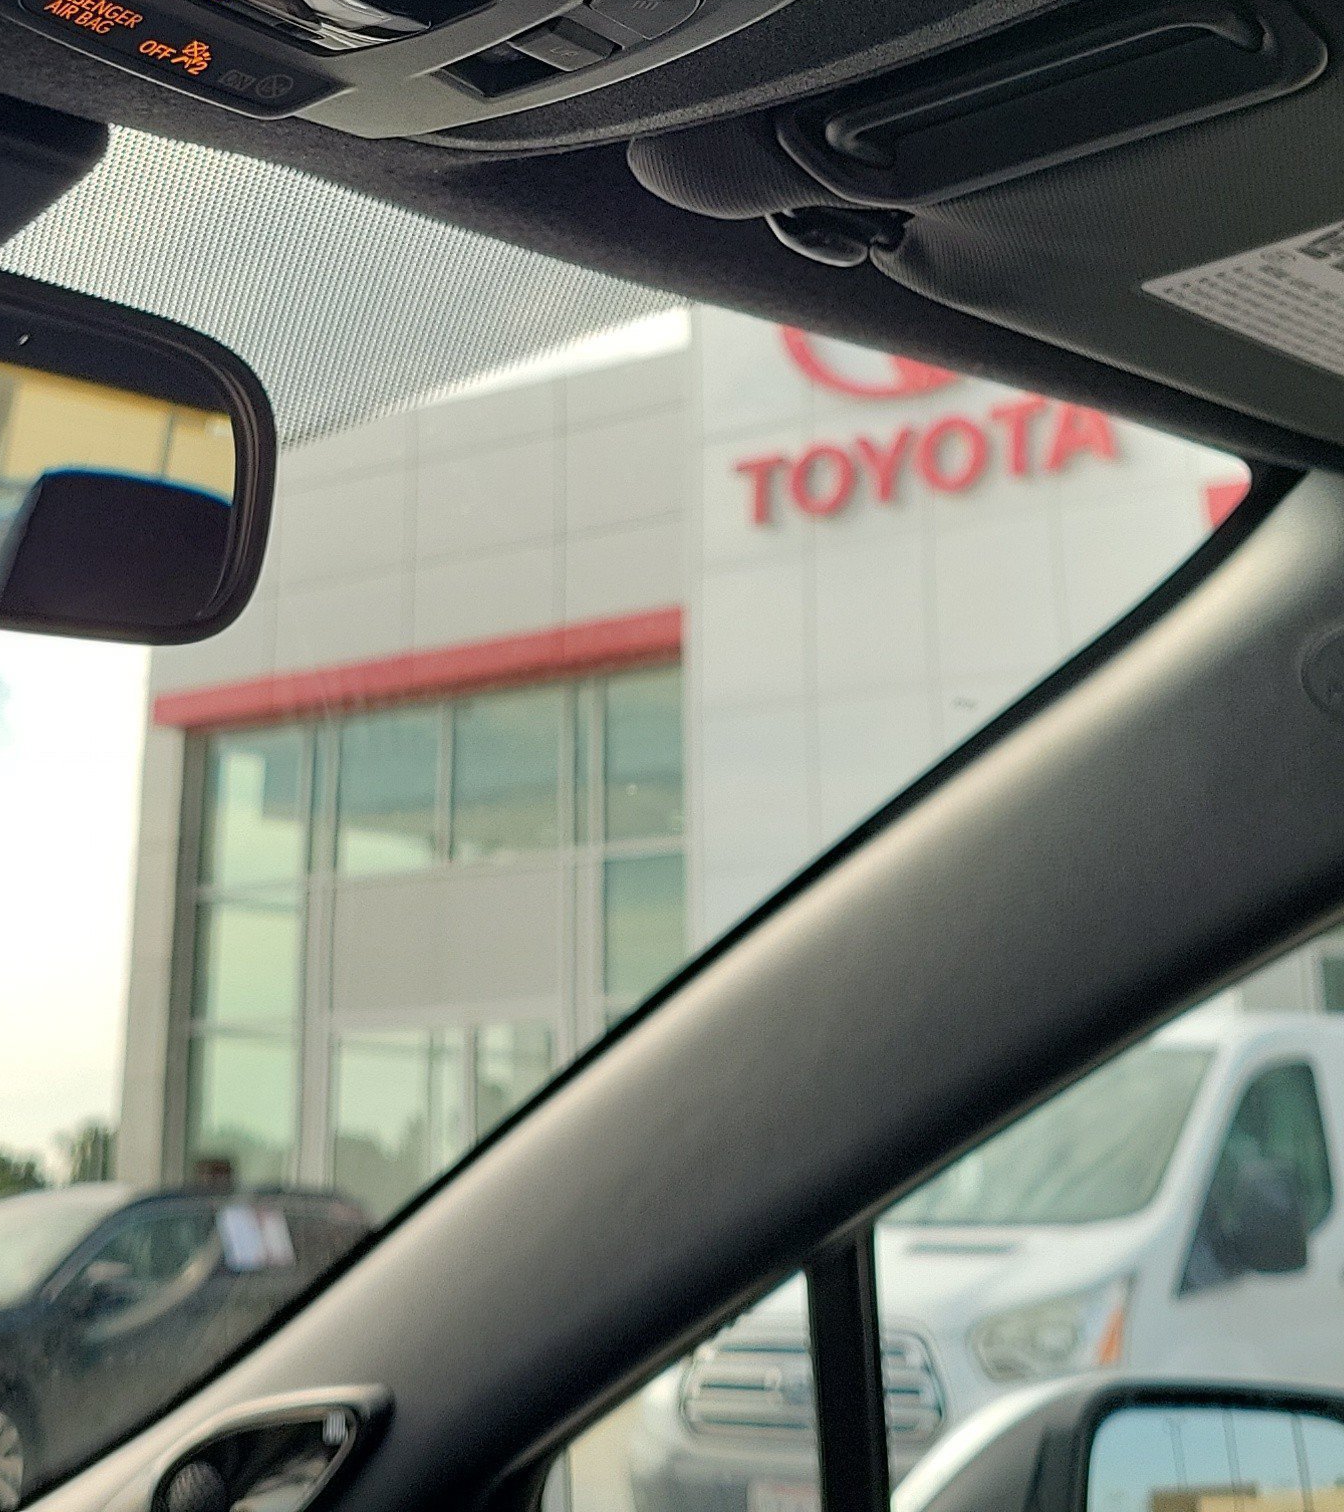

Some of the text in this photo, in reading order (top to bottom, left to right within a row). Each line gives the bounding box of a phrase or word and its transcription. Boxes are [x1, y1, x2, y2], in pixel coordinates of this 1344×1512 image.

[44, 0, 115, 35] AIR BAG
[138, 39, 177, 61] OFF
[735, 395, 1122, 525] TOYOTA
